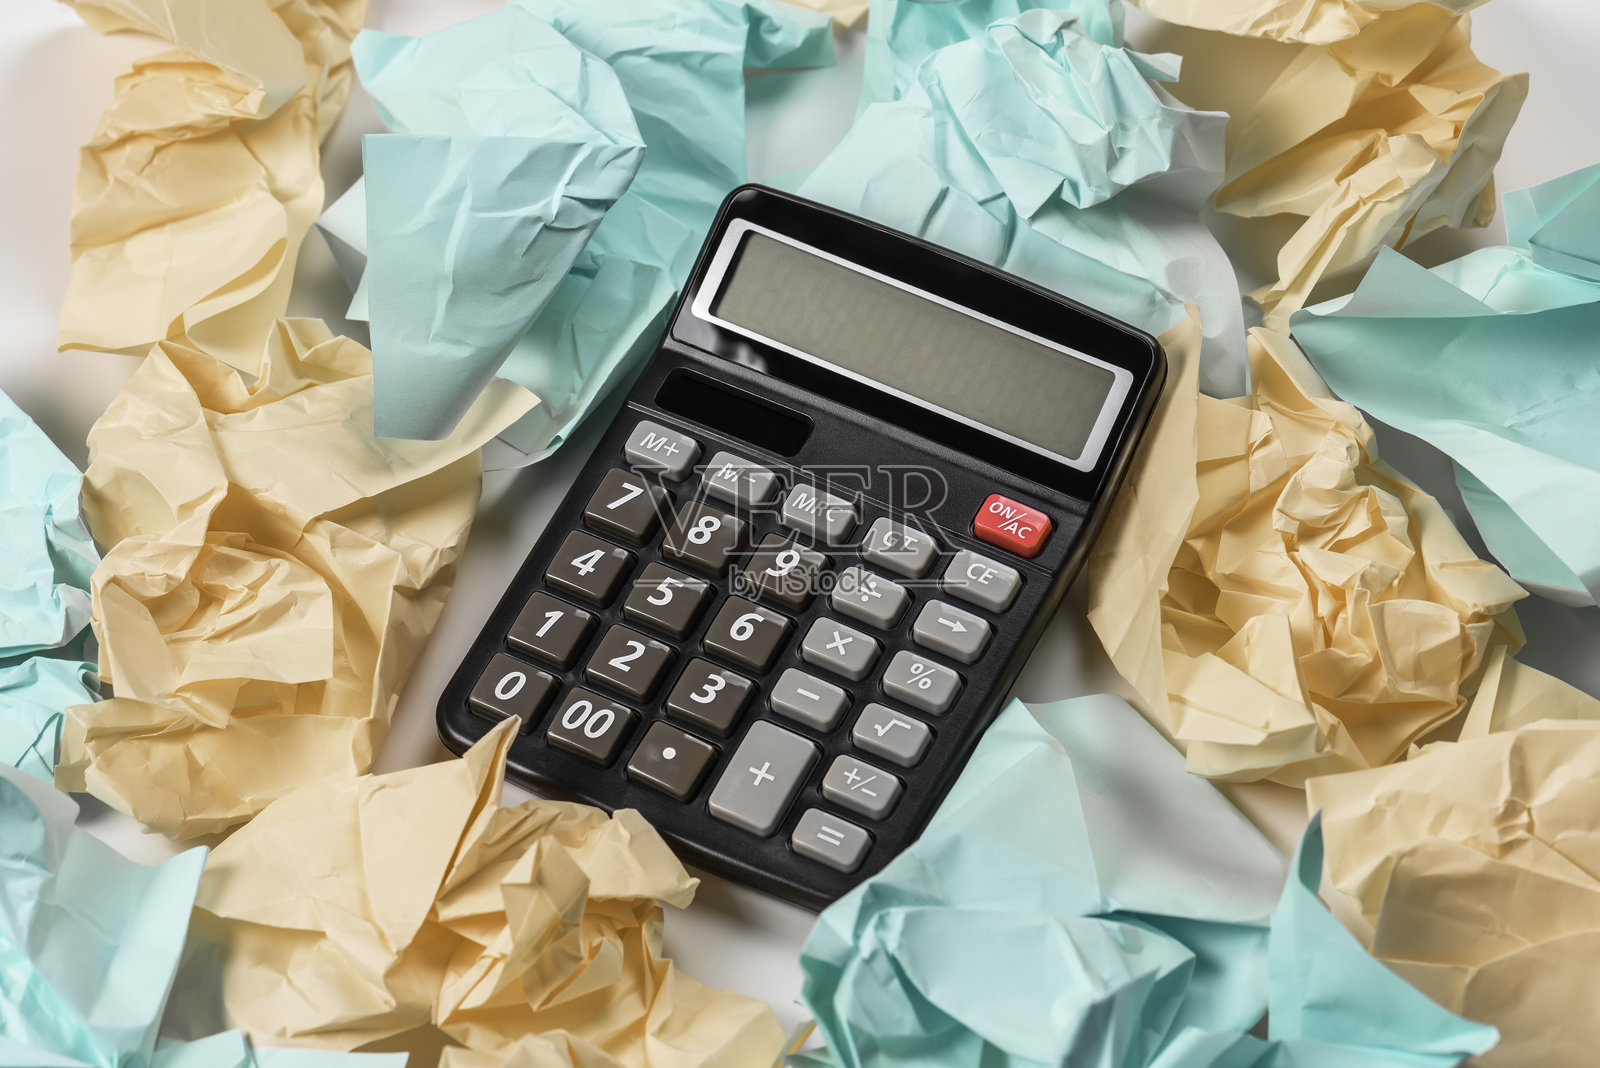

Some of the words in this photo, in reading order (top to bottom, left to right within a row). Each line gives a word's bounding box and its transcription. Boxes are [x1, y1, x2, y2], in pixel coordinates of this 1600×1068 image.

[639, 432, 680, 457] M+
[606, 482, 644, 510] 7
[791, 492, 846, 523] MRC
[687, 516, 721, 545] 8
[570, 549, 606, 577] 4
[765, 549, 801, 578] 9
[966, 563, 998, 585] CE
[646, 577, 684, 607] 5
[535, 610, 565, 638] 1
[729, 613, 765, 642] 6
[608, 640, 646, 673] 2
[494, 671, 527, 701] 0
[689, 673, 727, 705] 3
[906, 663, 937, 690] %
[561, 700, 616, 739] 00
